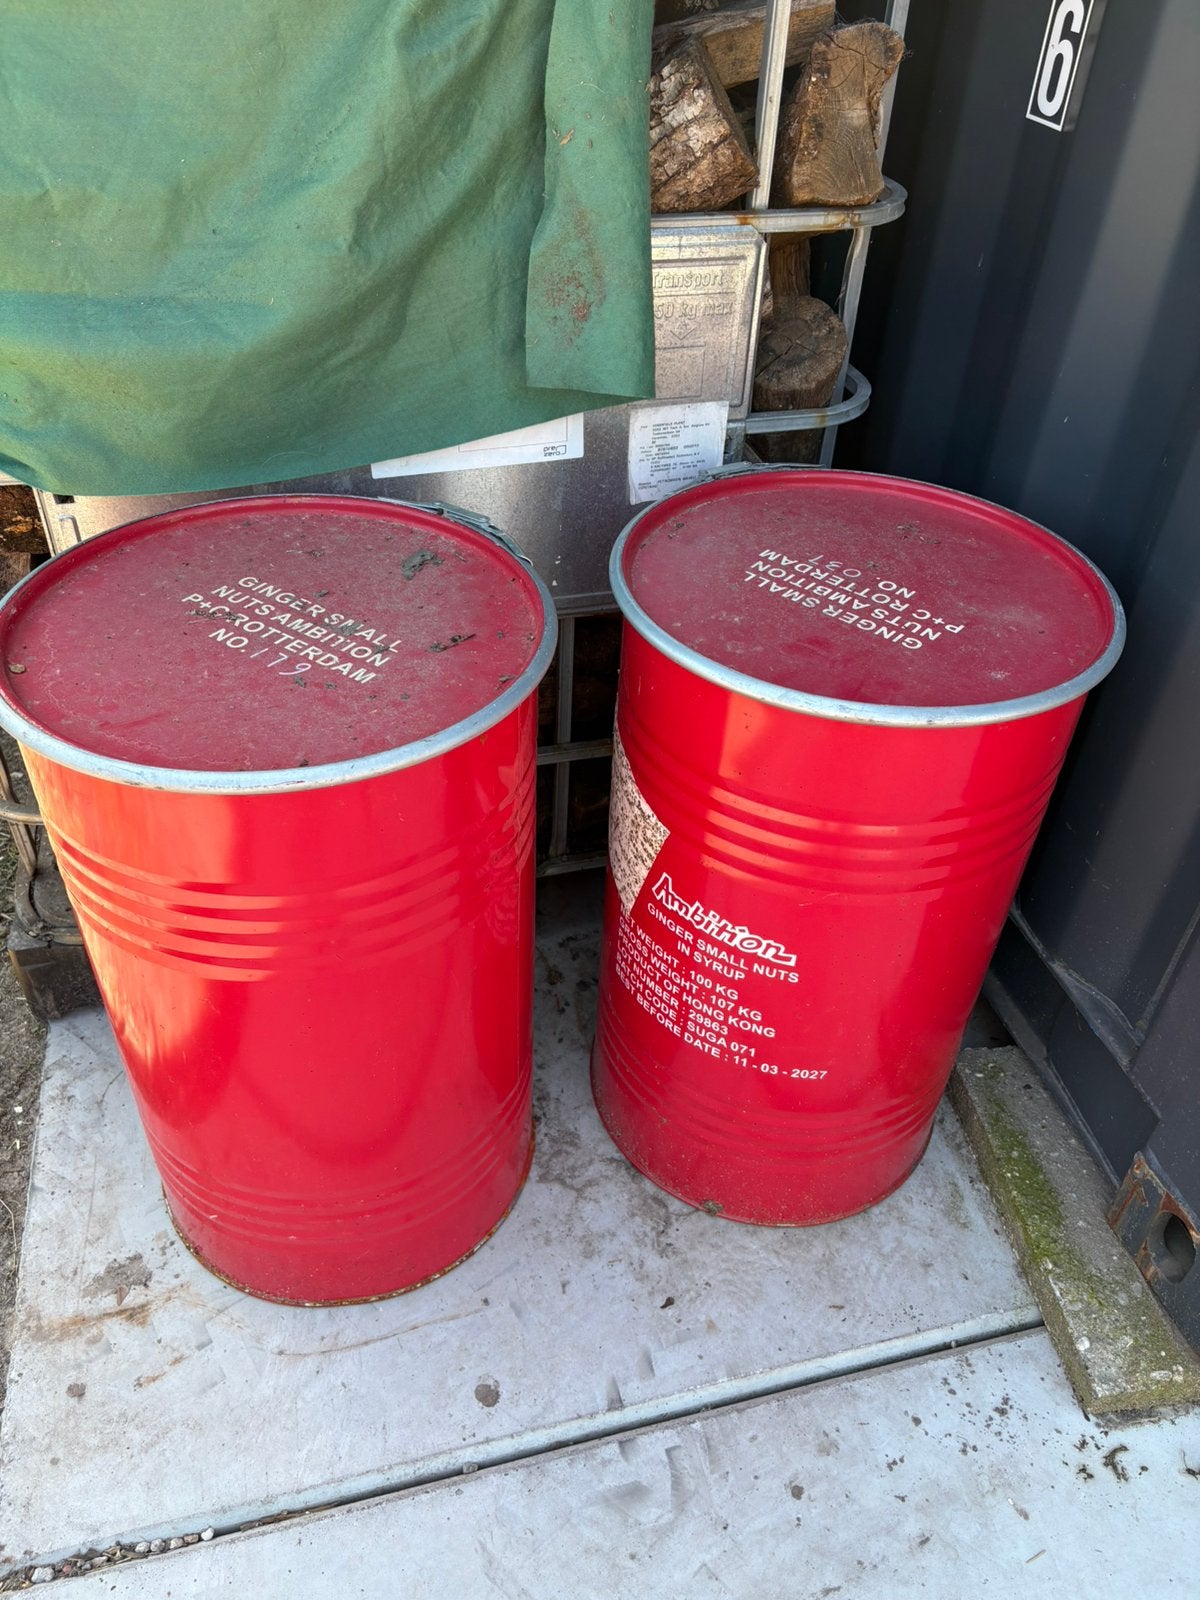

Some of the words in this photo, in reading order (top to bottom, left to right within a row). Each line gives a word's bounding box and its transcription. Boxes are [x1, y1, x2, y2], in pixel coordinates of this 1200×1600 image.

[1037, 0, 1085, 117] 6
[652, 271, 723, 290] Transport
[679, 302, 698, 320] kg
[702, 302, 733, 318] max
[238, 576, 326, 618] GINGER
[324, 612, 402, 654] SMALL
[743, 570, 821, 608] SMALL
[750, 560, 871, 610] AMBITION
[758, 549, 910, 612] ROTTERDAM
[876, 577, 916, 599] NO.
[208, 628, 249, 653] NO.
[211, 585, 276, 616] NUTS
[271, 612, 391, 668] AMBITION
[226, 613, 377, 684] ROTTERDAM
[822, 604, 923, 650] GINGER
[871, 608, 942, 641] NUTS
[912, 609, 965, 634] P+C
[647, 903, 694, 945] GINGER
[696, 937, 749, 970] SMALL
[753, 963, 799, 984] NUTS
[652, 871, 797, 967] Ambition
[617, 939, 632, 965] LOT
[633, 962, 679, 1011] NUMBER
[688, 1009, 729, 1036] 29863
[618, 928, 661, 982] PRODUCT
[663, 979, 680, 995] OF
[682, 991, 725, 1022] HONG
[728, 1015, 776, 1038] KONG
[619, 916, 648, 958] GROSS
[650, 953, 699, 994] WEIGHT
[710, 994, 735, 1011] 107
[738, 1005, 762, 1022] KG
[636, 925, 680, 968] WEIGHT
[689, 970, 713, 989] 100
[715, 983, 739, 1001] KG
[677, 940, 691, 957] IN
[693, 953, 746, 982] SYRUP
[615, 963, 636, 995] BEST
[636, 992, 682, 1038] BEFORE
[683, 1031, 721, 1060] DATE
[733, 1055, 747, 1068] 11
[760, 1063, 778, 1075] 03
[790, 1068, 828, 1081] 2027
[616, 951, 643, 992] BATCH
[644, 989, 677, 1021] CODE
[686, 1021, 727, 1048] SUGA
[730, 1041, 756, 1057] 071
